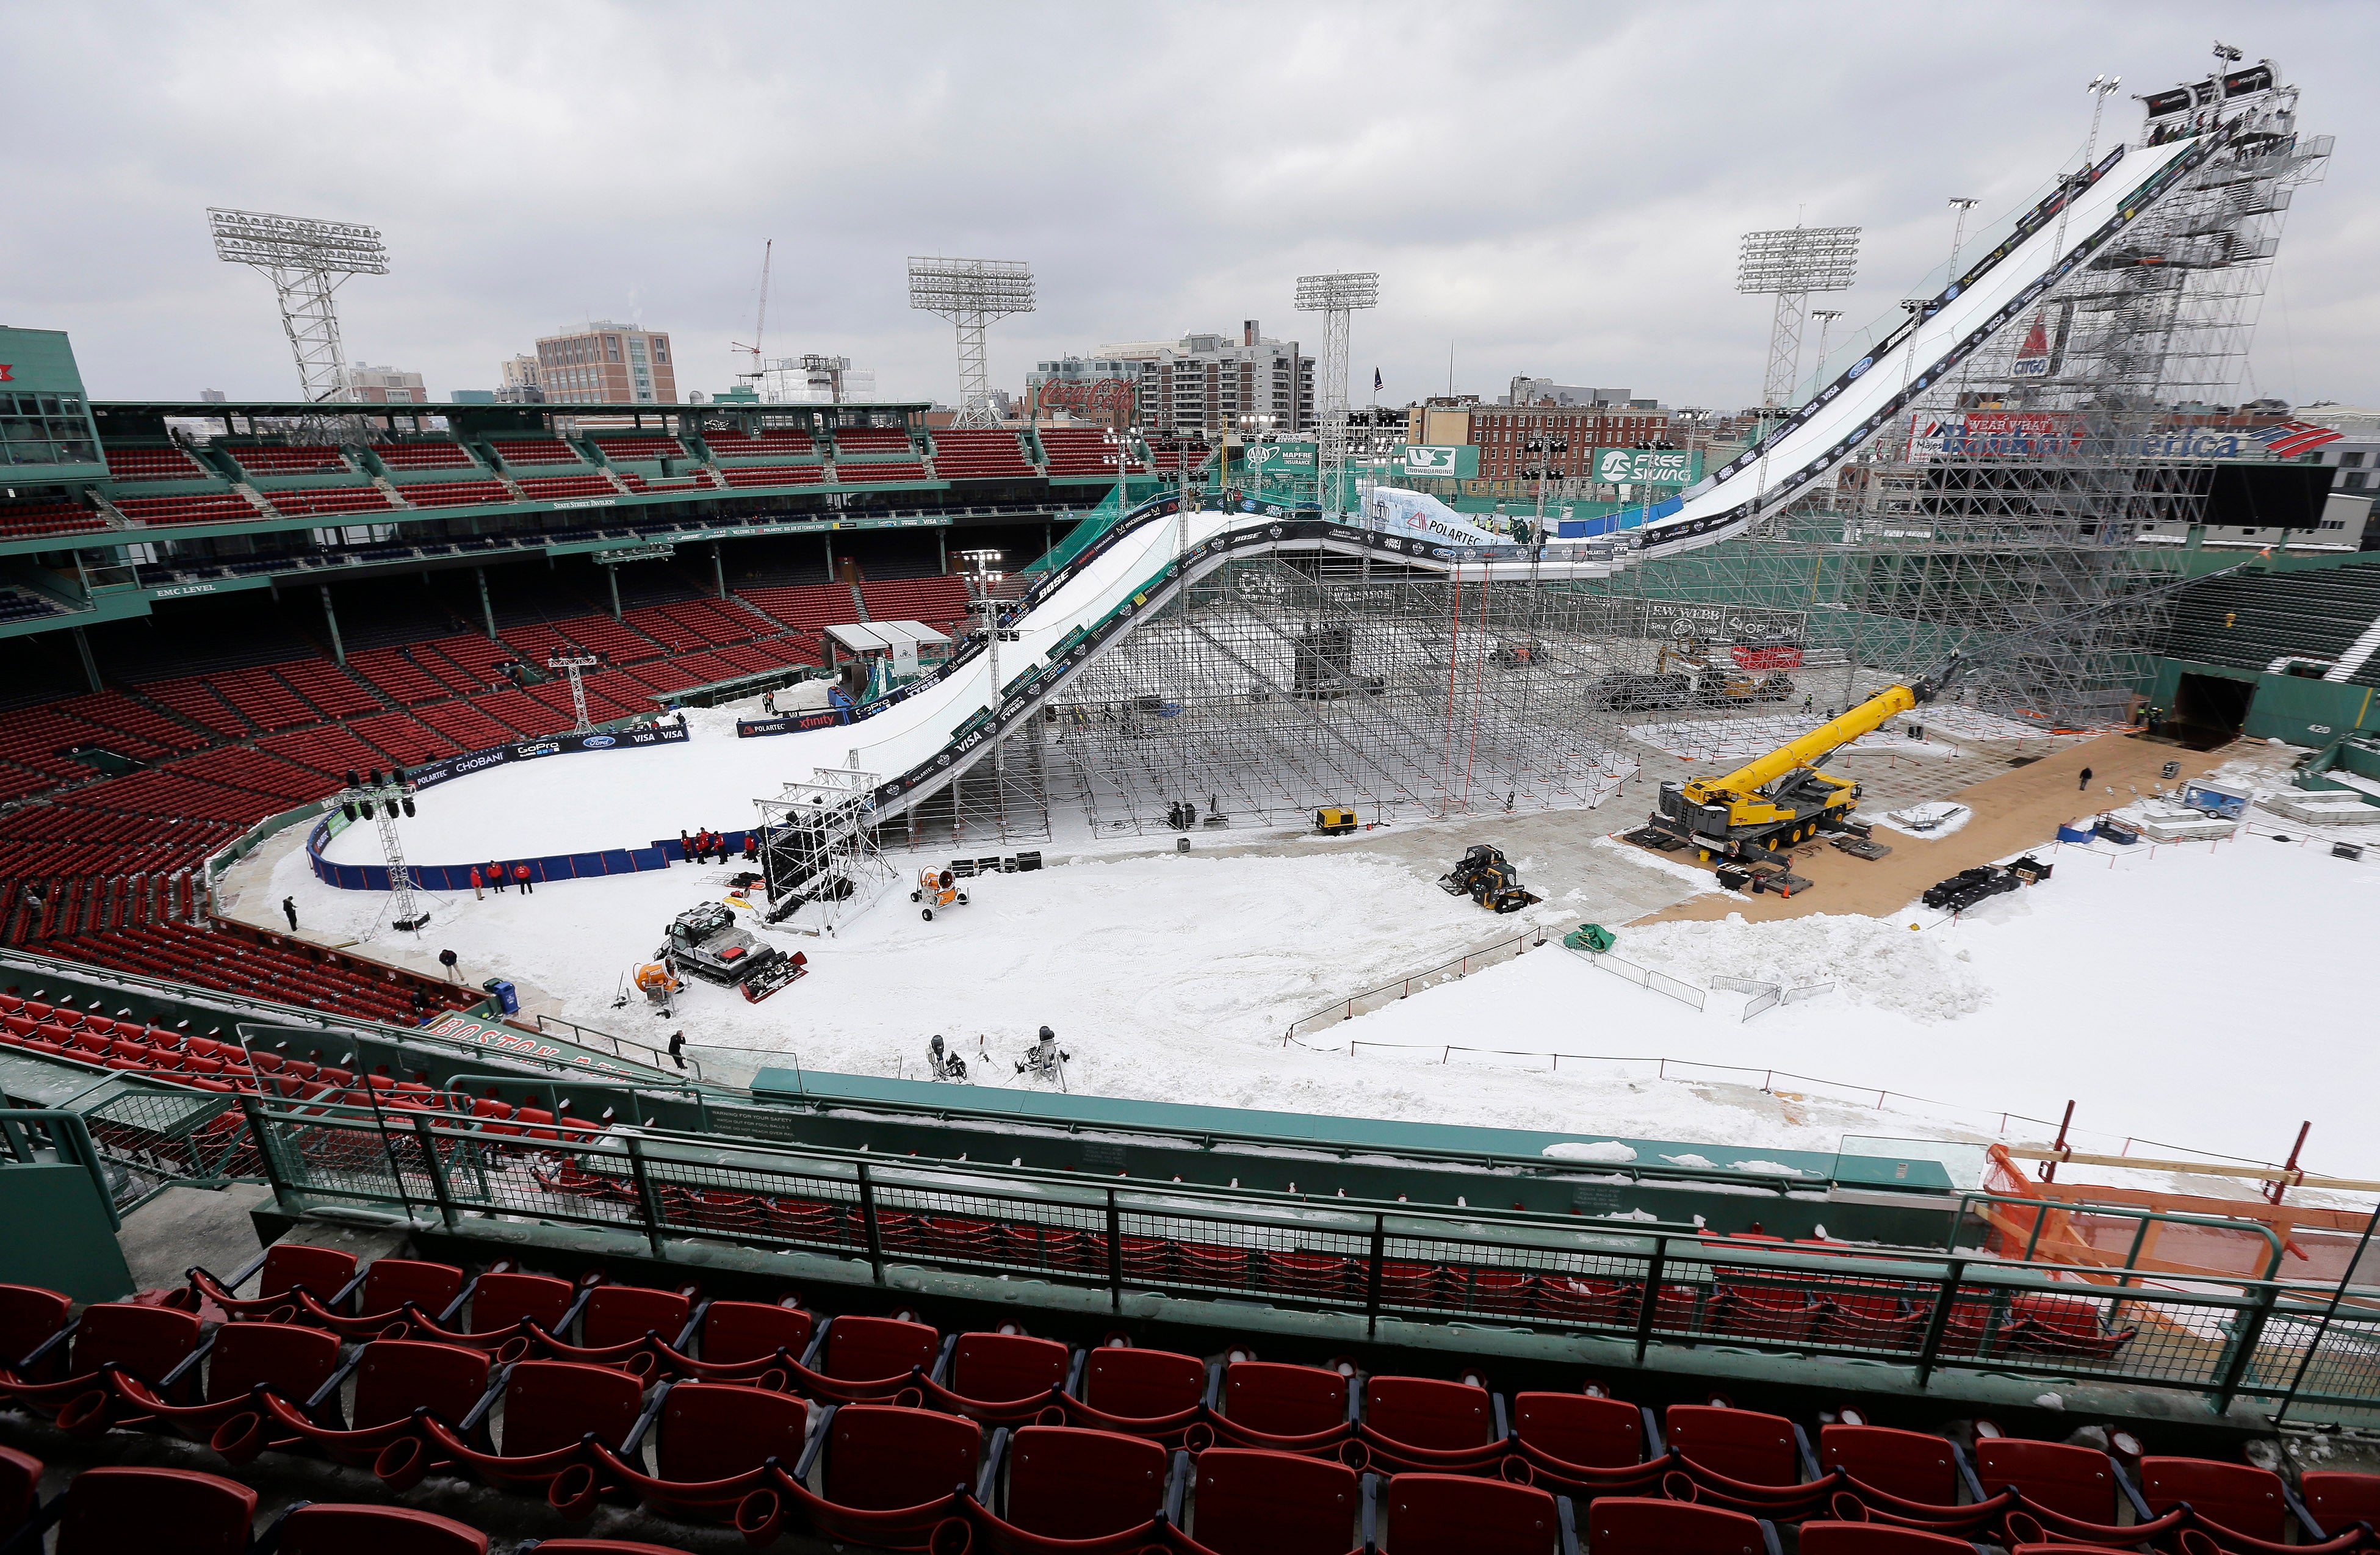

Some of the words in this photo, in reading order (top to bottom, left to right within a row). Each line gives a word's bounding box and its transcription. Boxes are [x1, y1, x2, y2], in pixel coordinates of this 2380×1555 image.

[1985, 313, 2007, 332] VISA
[2016, 359, 2047, 375] CITGO
[1038, 378, 1139, 409] Coca-Cola
[1822, 385, 1840, 401] VISA
[1801, 402, 1820, 417] VISA
[1634, 454, 1686, 467] FREE
[1231, 532, 1263, 543] BOSE
[1429, 519, 1481, 546] POLARTEC
[1665, 529, 1689, 538] LIFEPROOF
[1078, 549, 1095, 565] MAPFRE
[1182, 549, 1208, 569] LIFEPROOF
[182, 585, 216, 593] LEVEL
[1029, 574, 1049, 593] LIFEPROOF
[1035, 566, 1072, 604] BOSE
[1651, 621, 1667, 630] Since
[1043, 658, 1069, 680] GoPro
[907, 677, 941, 698] TYRES
[856, 699, 890, 715] GoPro
[1001, 699, 1026, 721] TYRES
[754, 723, 785, 732] POLARTEC
[799, 715, 835, 729] xfinity
[958, 712, 986, 736] LIFEPROOF
[2307, 724, 2331, 734] 420
[632, 734, 655, 743] VISA
[661, 730, 683, 739] VISA
[954, 731, 983, 752] VISA
[517, 742, 559, 754] GoPro
[456, 752, 503, 772] CHOBANI
[417, 770, 447, 785] POLARTEC
[912, 766, 934, 783] POLARTEC
